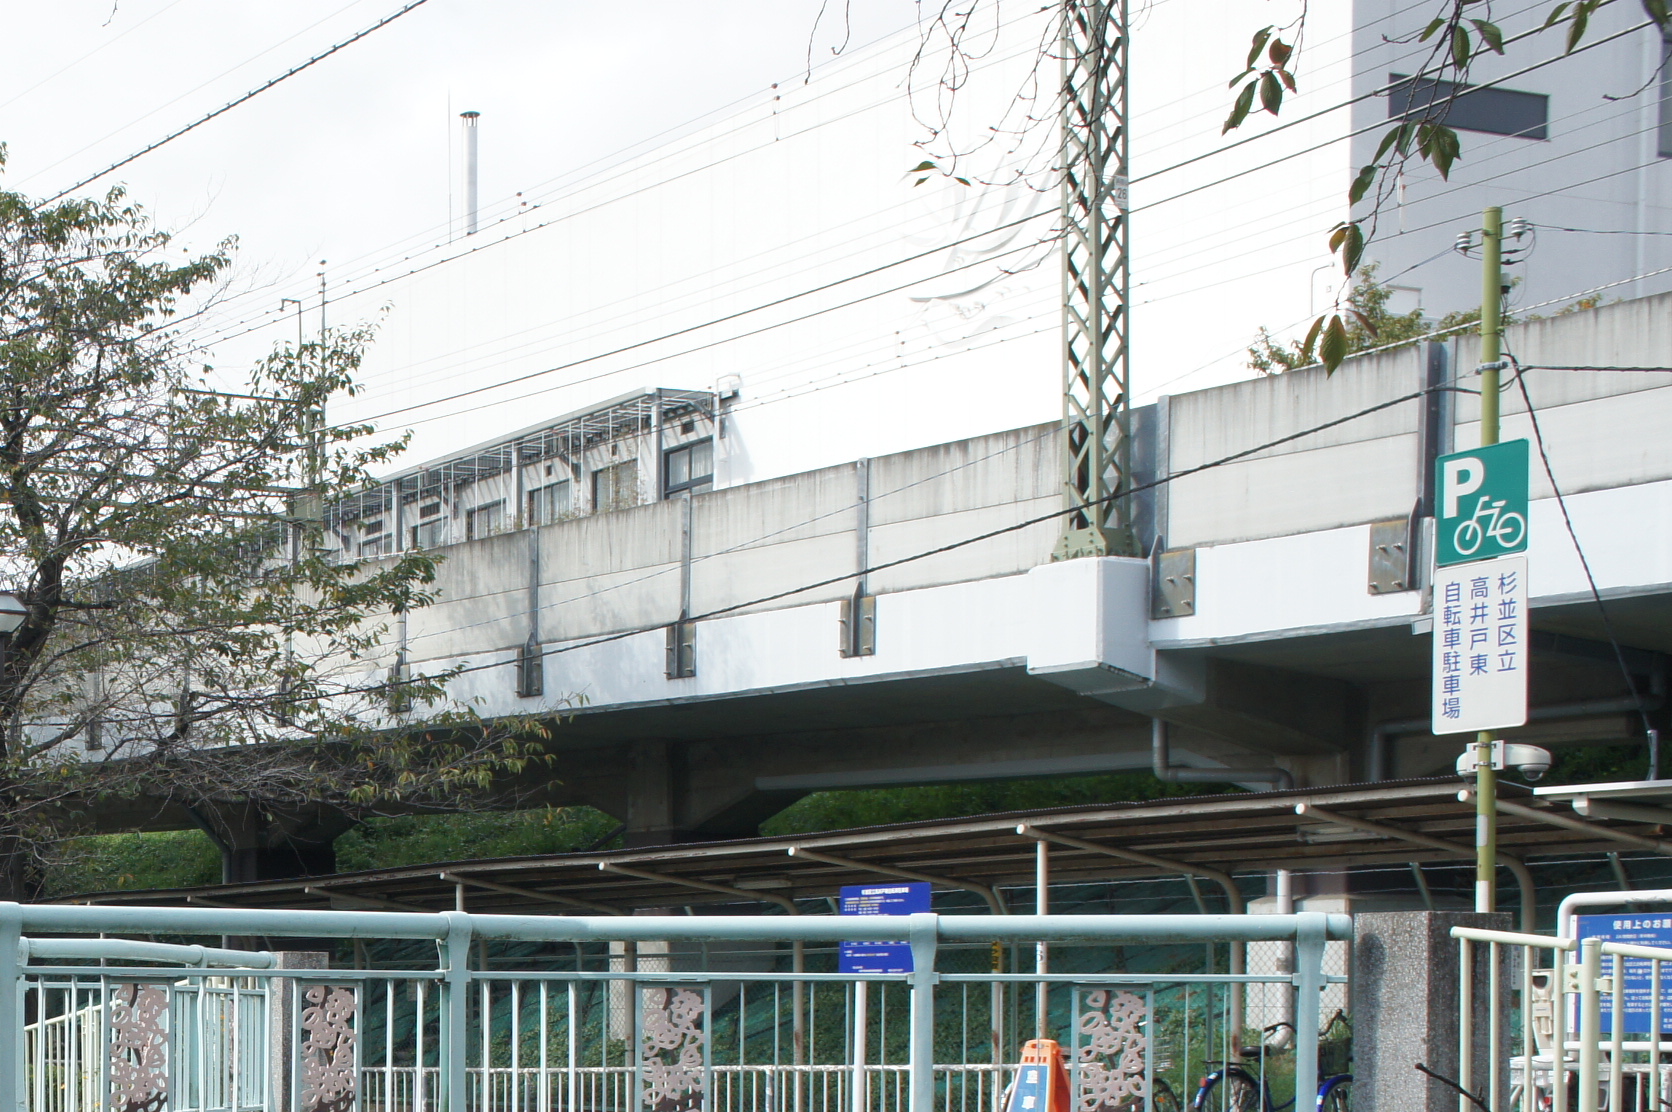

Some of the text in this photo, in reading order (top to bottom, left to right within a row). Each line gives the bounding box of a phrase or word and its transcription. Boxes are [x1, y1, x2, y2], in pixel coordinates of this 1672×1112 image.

[1443, 456, 1485, 519] P
[1441, 581, 1461, 719] 自転車駐車場
[1469, 576, 1489, 676] 高井戸東
[1497, 571, 1517, 673] 杉並区立
